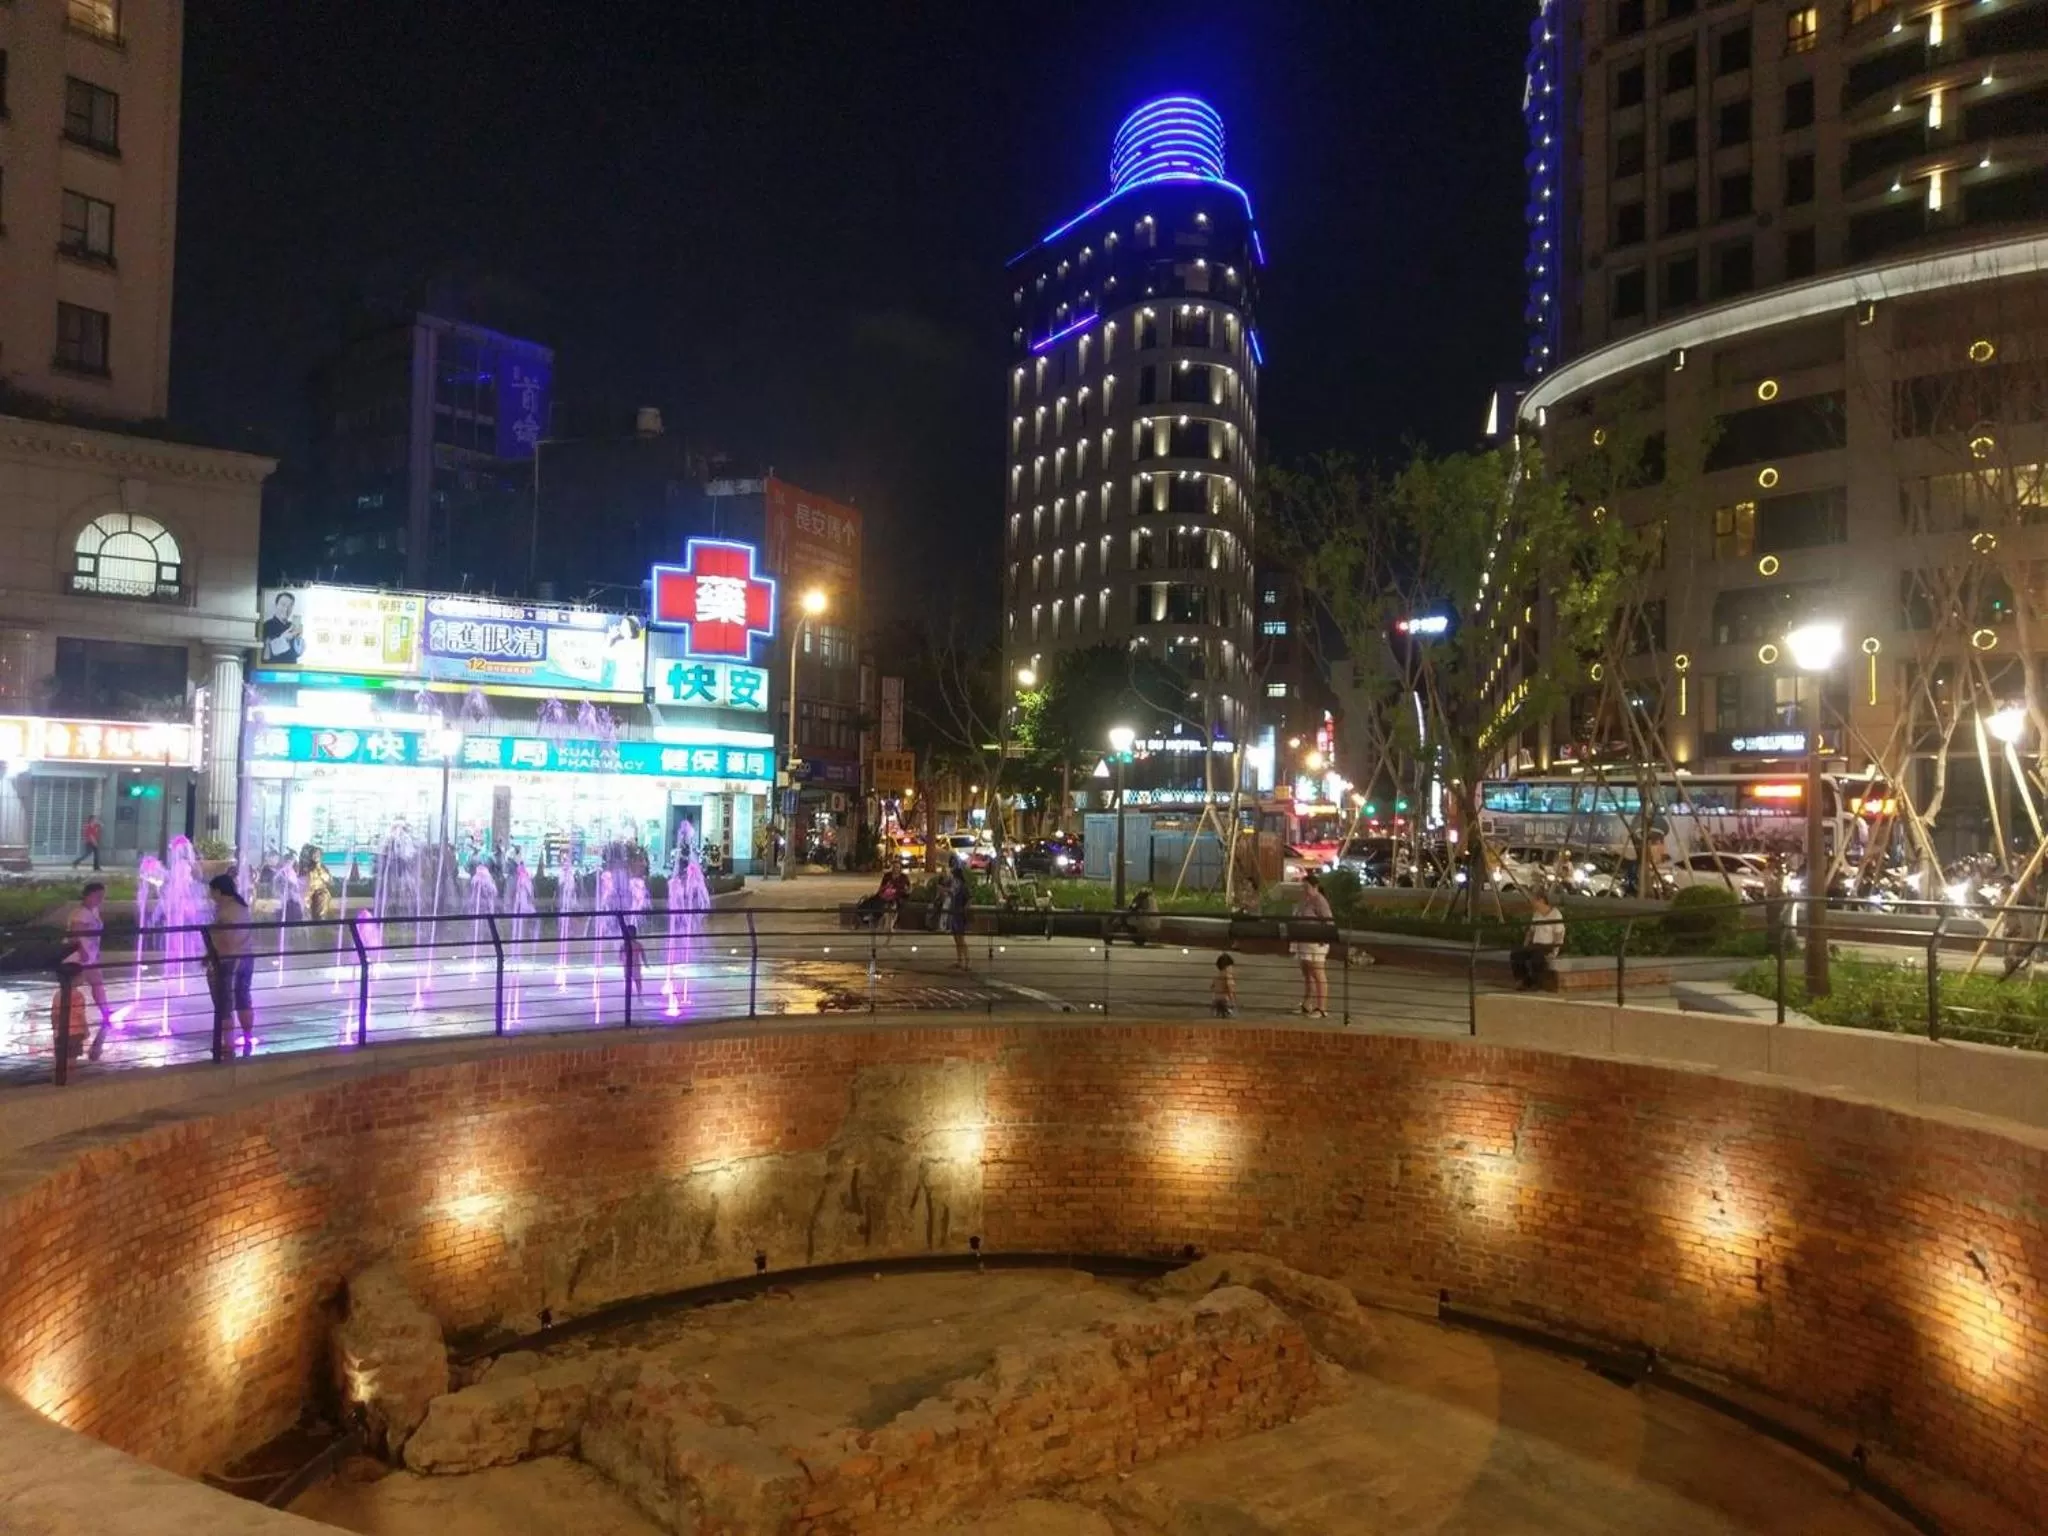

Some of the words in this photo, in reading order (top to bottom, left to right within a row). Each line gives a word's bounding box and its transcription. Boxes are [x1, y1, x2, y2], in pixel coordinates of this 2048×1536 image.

[695, 575, 748, 625] 藥
[448, 622, 543, 657] 護眼清
[468, 658, 487, 671] 12
[667, 663, 763, 708] 快安
[557, 757, 645, 770] PHARMACY
[660, 748, 765, 776] 健保藥局
